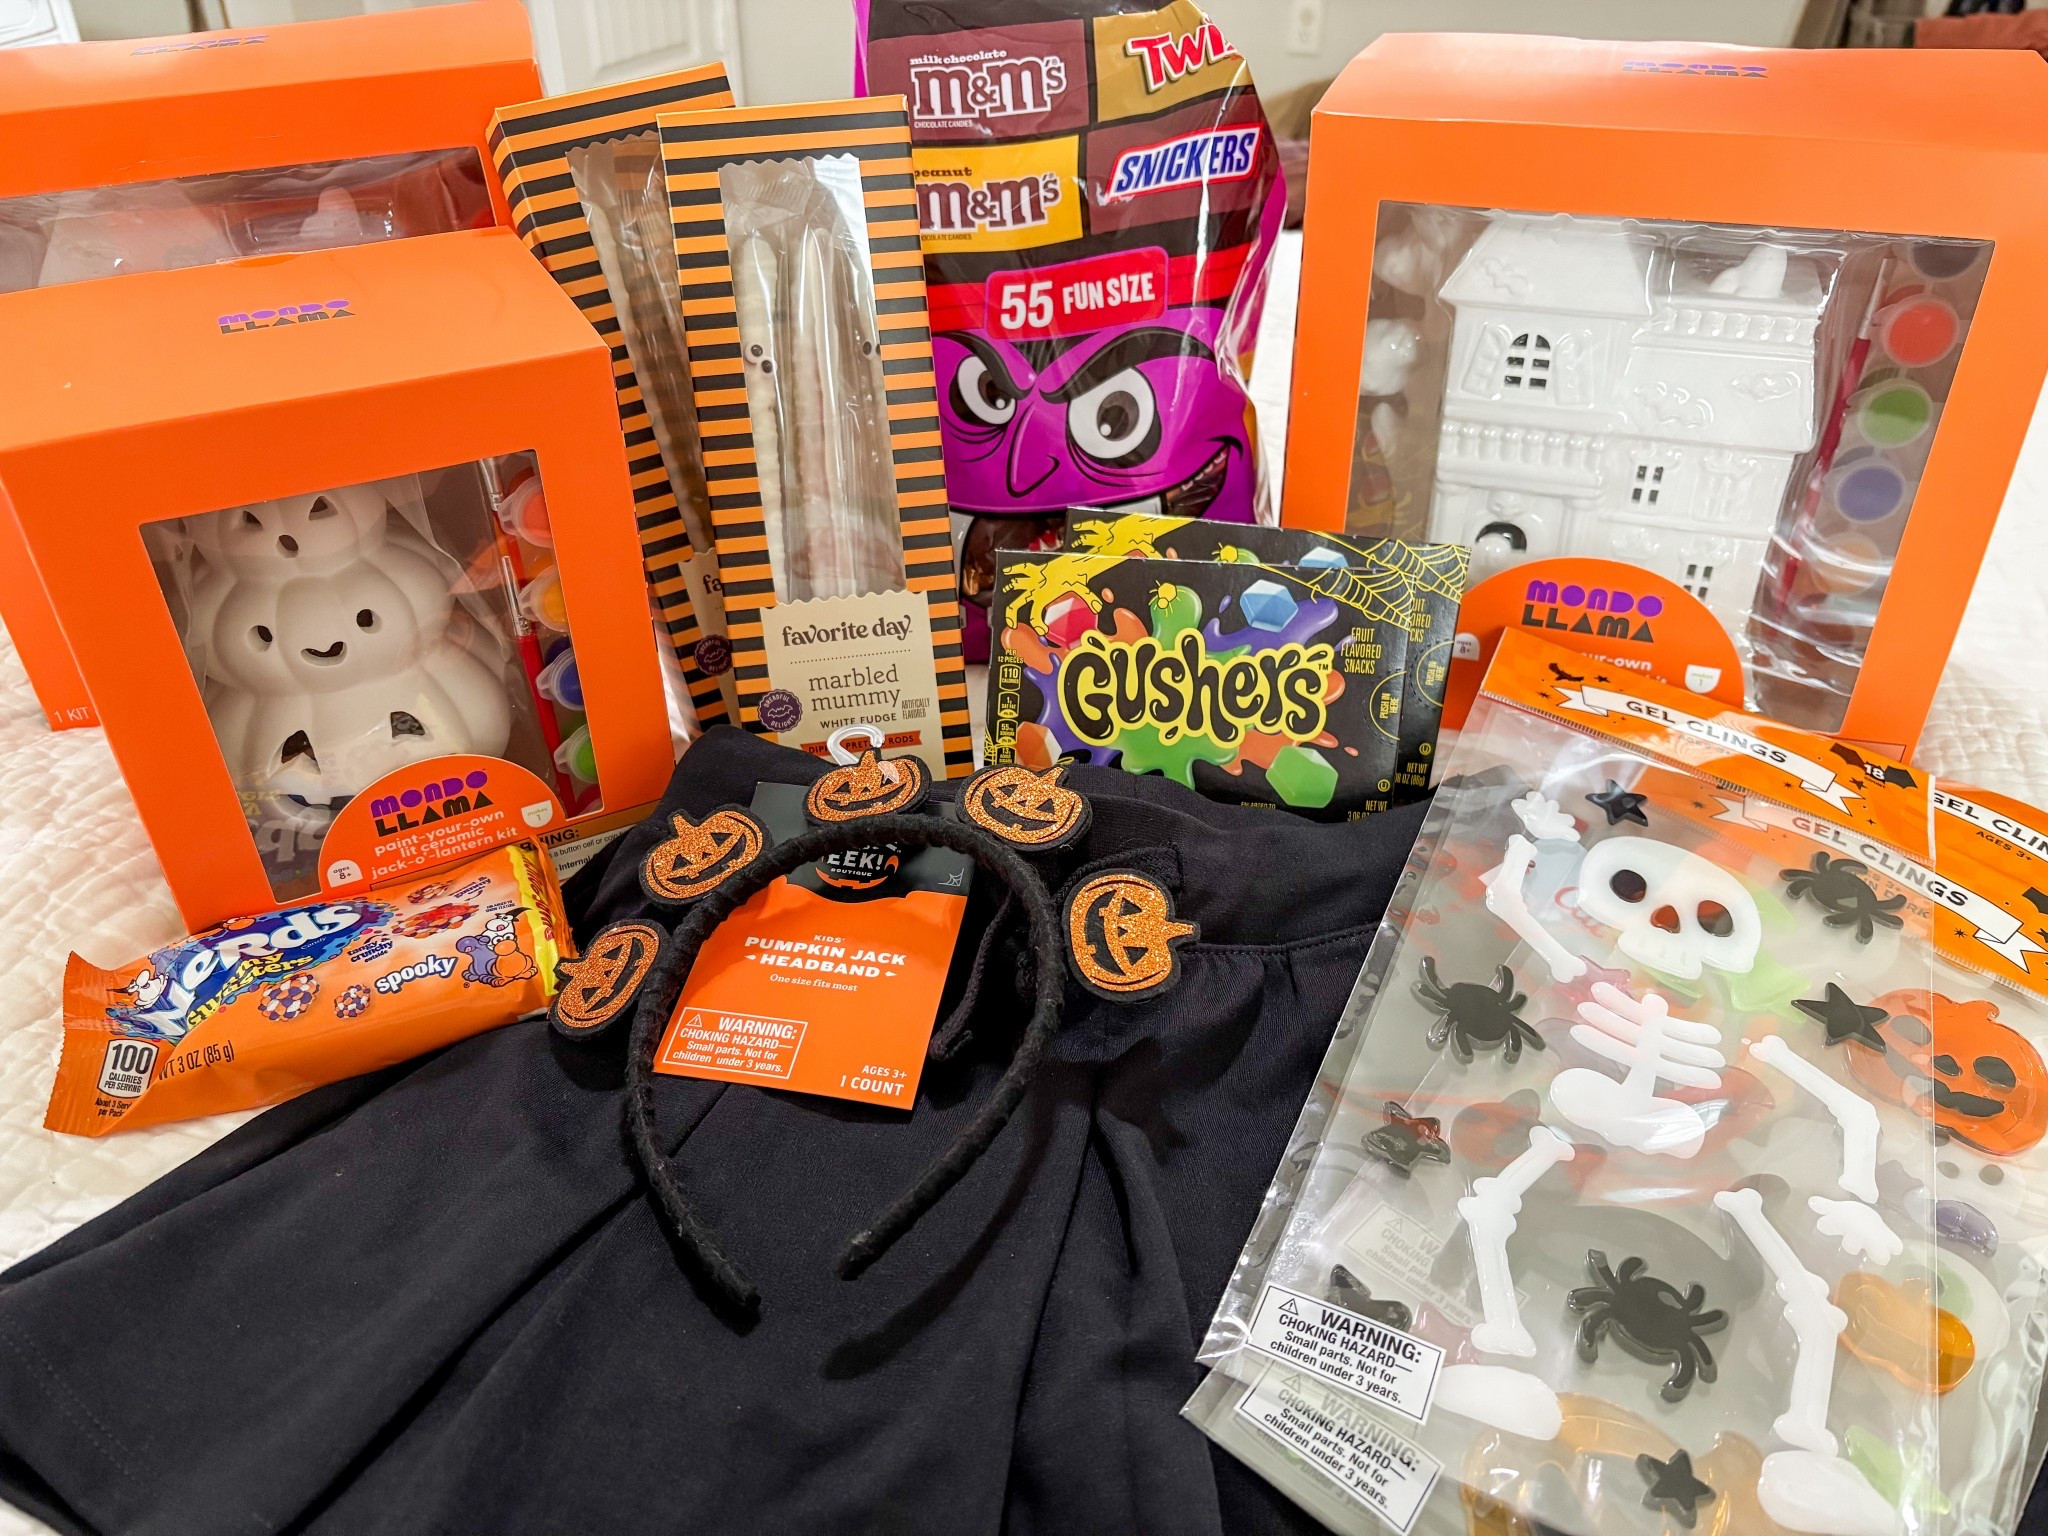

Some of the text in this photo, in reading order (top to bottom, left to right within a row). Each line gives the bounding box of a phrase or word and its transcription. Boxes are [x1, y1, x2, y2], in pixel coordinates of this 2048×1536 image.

[910, 49, 1008, 66] milk chocolate
[1127, 18, 1240, 92] TWI
[914, 120, 948, 129] CHOCOLATE
[1115, 132, 1257, 193] SNICKERS
[1000, 272, 1156, 330] 55 FUN SIZE
[782, 614, 911, 647] favorite day
[1352, 627, 1375, 642] FRUIT
[1521, 604, 1655, 643] LLAMA
[1004, 656, 1024, 664] PIECES
[1340, 643, 1382, 659] FLAVORED
[809, 663, 900, 692] marbled
[1003, 667, 1019, 679] 110
[1344, 658, 1376, 675] SNACKS
[811, 688, 901, 712] mummy
[1060, 631, 1330, 745] Gushers
[53, 706, 89, 723] 1 KIT
[770, 713, 797, 729] DELIGHTS
[820, 712, 897, 729] WHITE FUDGE
[888, 735, 914, 745] RODS
[1626, 700, 1676, 724] GEL
[1687, 720, 1787, 764] CLINGS
[1863, 762, 1885, 780] 18
[374, 790, 494, 837] LLAMA
[1365, 800, 1388, 811] NET WT
[374, 810, 505, 857] paint-your-own
[496, 826, 518, 841] kit
[1934, 792, 2048, 857] GEL CLIN
[400, 827, 485, 859] lit ceramic
[559, 845, 582, 857] button
[582, 839, 594, 849] cell
[1976, 830, 2034, 862] AGES 3+
[333, 865, 350, 875] ages
[830, 867, 873, 877] BOUTIQUE
[1791, 816, 1969, 907] GEL CLINGS
[339, 871, 352, 881] 8+
[1884, 889, 1930, 919] DRK
[350, 940, 393, 963] crunchy
[744, 936, 907, 966] PUMPKIN JACK
[375, 955, 459, 995] spooky
[760, 953, 881, 978] HEADBAND
[769, 973, 858, 992] One size fits most
[680, 1028, 730, 1044] CHOKING
[718, 1016, 798, 1040] WARNING:
[111, 1043, 154, 1075] 100
[178, 1055, 185, 1074] 3
[187, 1049, 203, 1070] OZ
[203, 1043, 222, 1067] (85
[672, 1050, 783, 1073] children under 3 years.
[687, 1040, 779, 1060] Small parts. Not for
[108, 1072, 143, 1085] CALORIES
[861, 1064, 908, 1080] AGES 3+
[104, 1080, 142, 1093] PER SERVING
[840, 1074, 905, 1097] 1 COUNT
[95, 1097, 111, 1106] About
[98, 1108, 108, 1117] per
[1278, 1313, 1338, 1345] CHOKING
[1321, 1308, 1423, 1364] WARNING:
[1285, 1330, 1398, 1385] Small parts. Not for
[1270, 1339, 1402, 1405] children under 3 years.
[1278, 1388, 1334, 1432] CHOKING
[1321, 1392, 1421, 1472] WARNING:
[1280, 1407, 1389, 1487] Small parts. Not for
[1264, 1412, 1388, 1509] children under 3 years.
